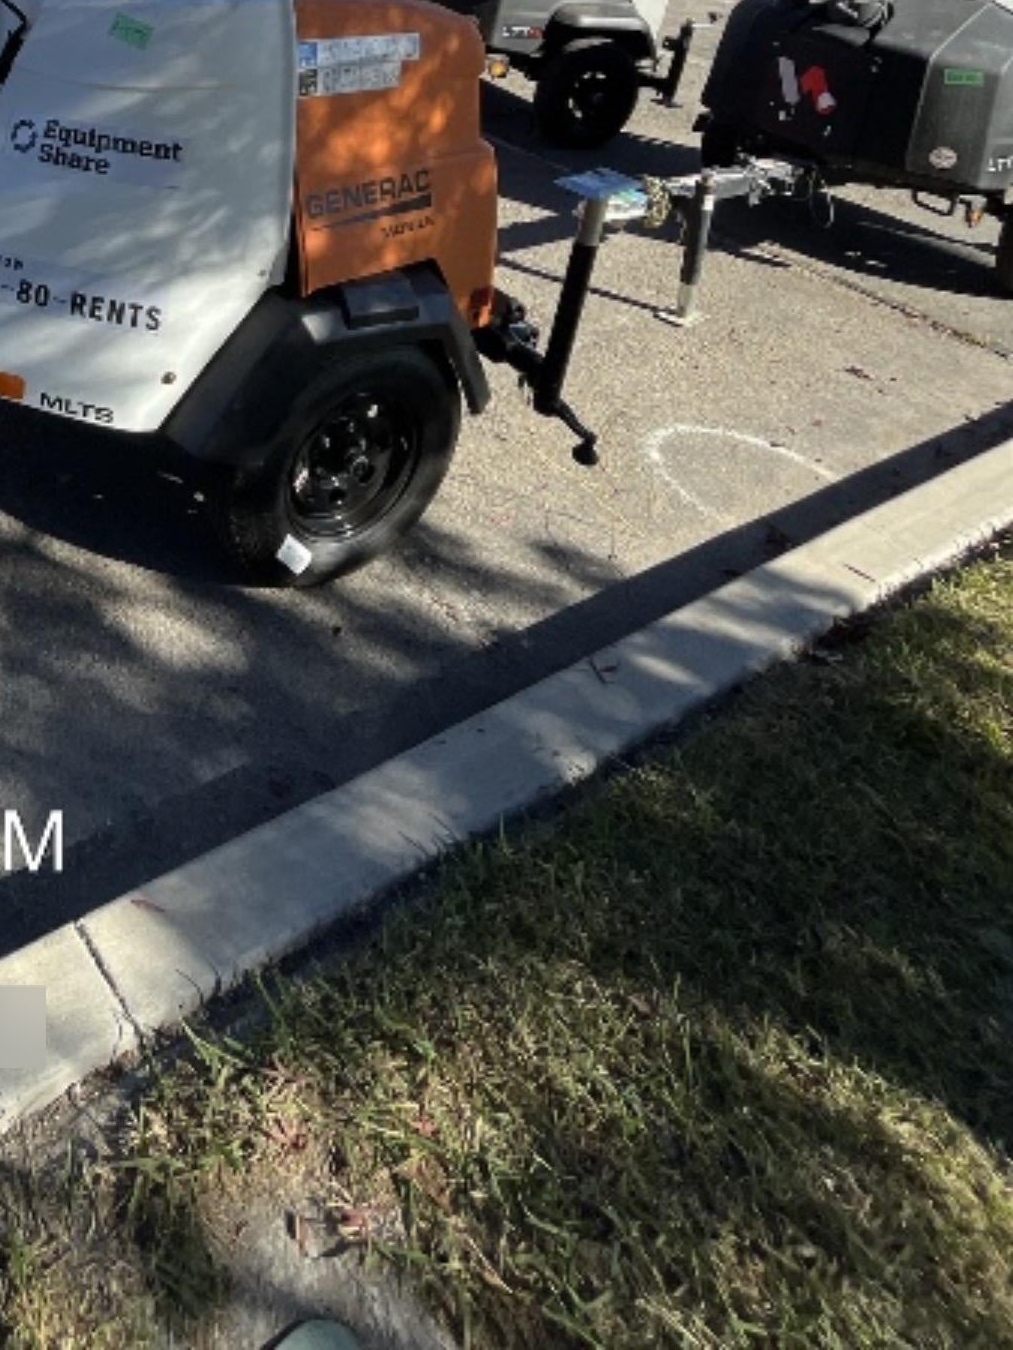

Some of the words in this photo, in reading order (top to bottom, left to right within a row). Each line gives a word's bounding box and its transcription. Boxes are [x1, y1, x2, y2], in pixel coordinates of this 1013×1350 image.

[37, 143, 111, 175] Share
[42, 118, 184, 162] Equipment
[306, 169, 432, 219] GENERAC
